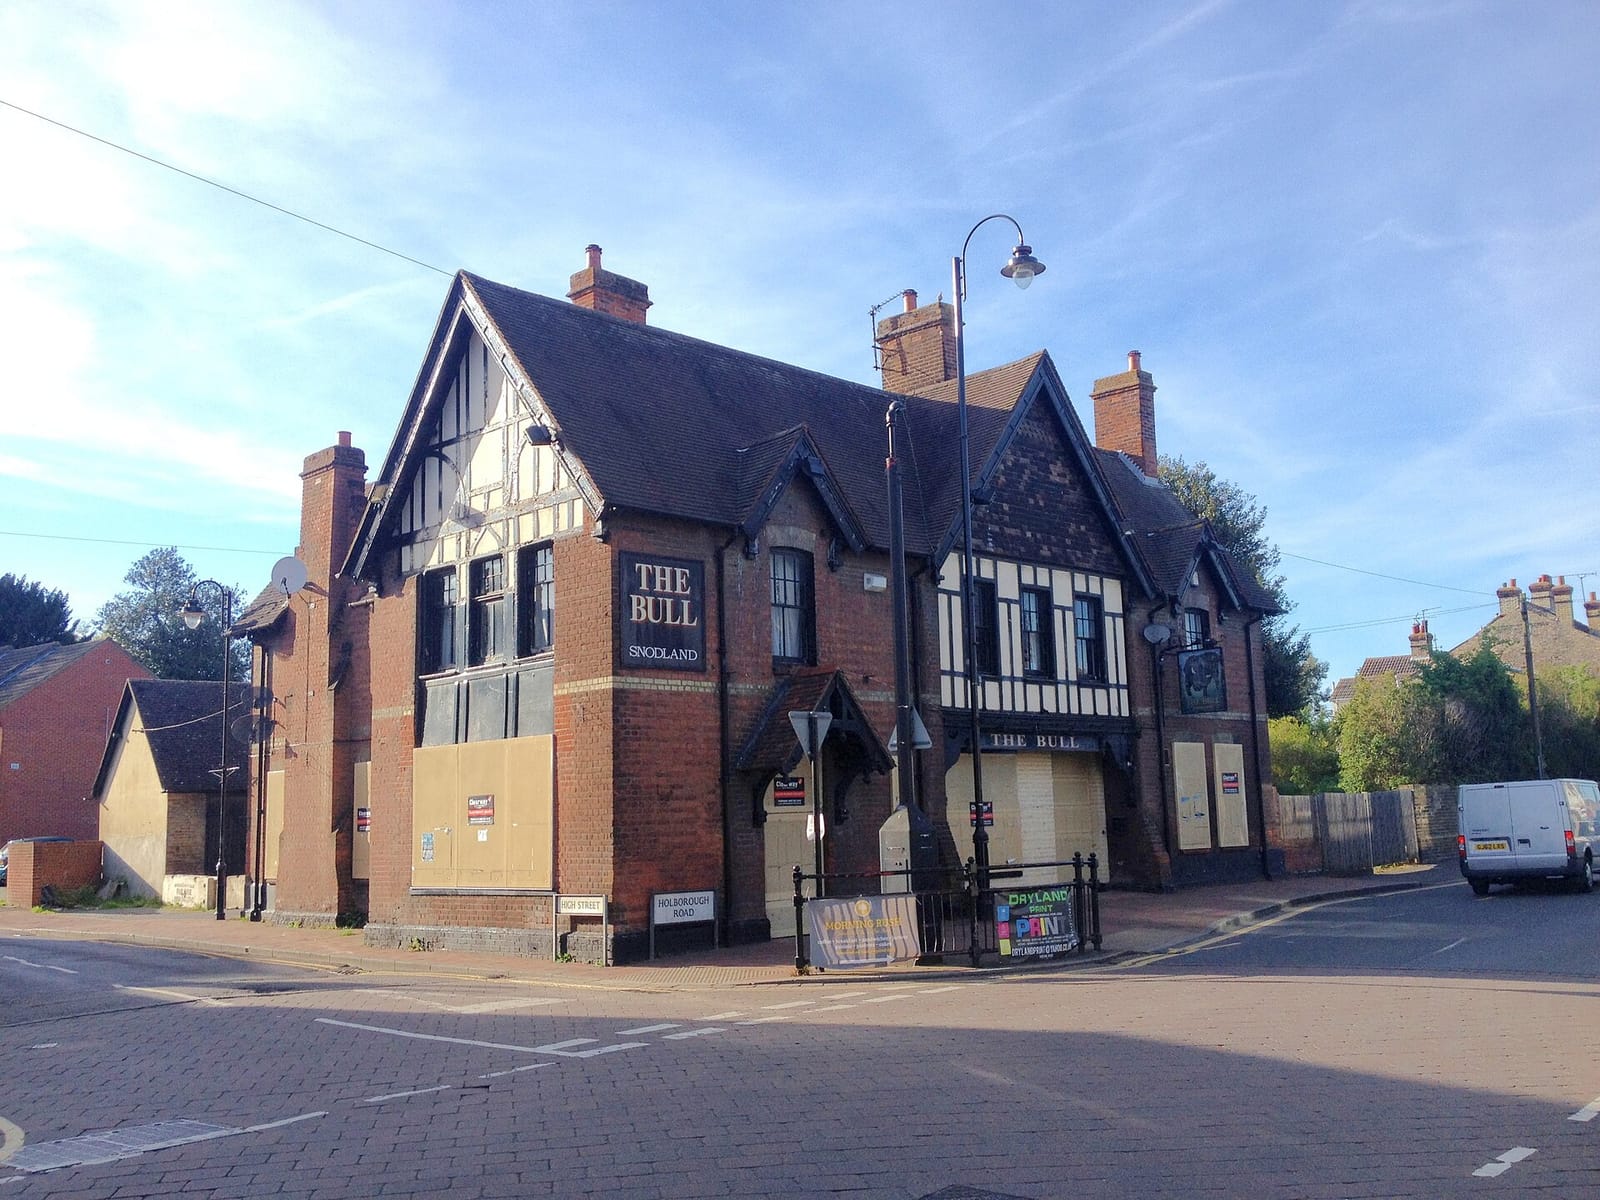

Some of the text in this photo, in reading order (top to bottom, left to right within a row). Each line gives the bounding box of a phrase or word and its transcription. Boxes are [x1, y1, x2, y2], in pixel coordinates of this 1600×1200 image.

[635, 563, 691, 594] THE
[629, 595, 698, 626] BULL
[629, 645, 698, 660] SNODLAND
[991, 734, 1080, 748] THE BULL
[658, 896, 709, 908] HOLBOROUGH
[1008, 890, 1068, 905] DRYLAND
[561, 900, 600, 910] HIGH STREET
[1029, 905, 1053, 913] PRINT
[673, 908, 695, 918] ROAD
[825, 917, 902, 930] MORNING RUSH
[1016, 916, 1068, 938] PRINT
